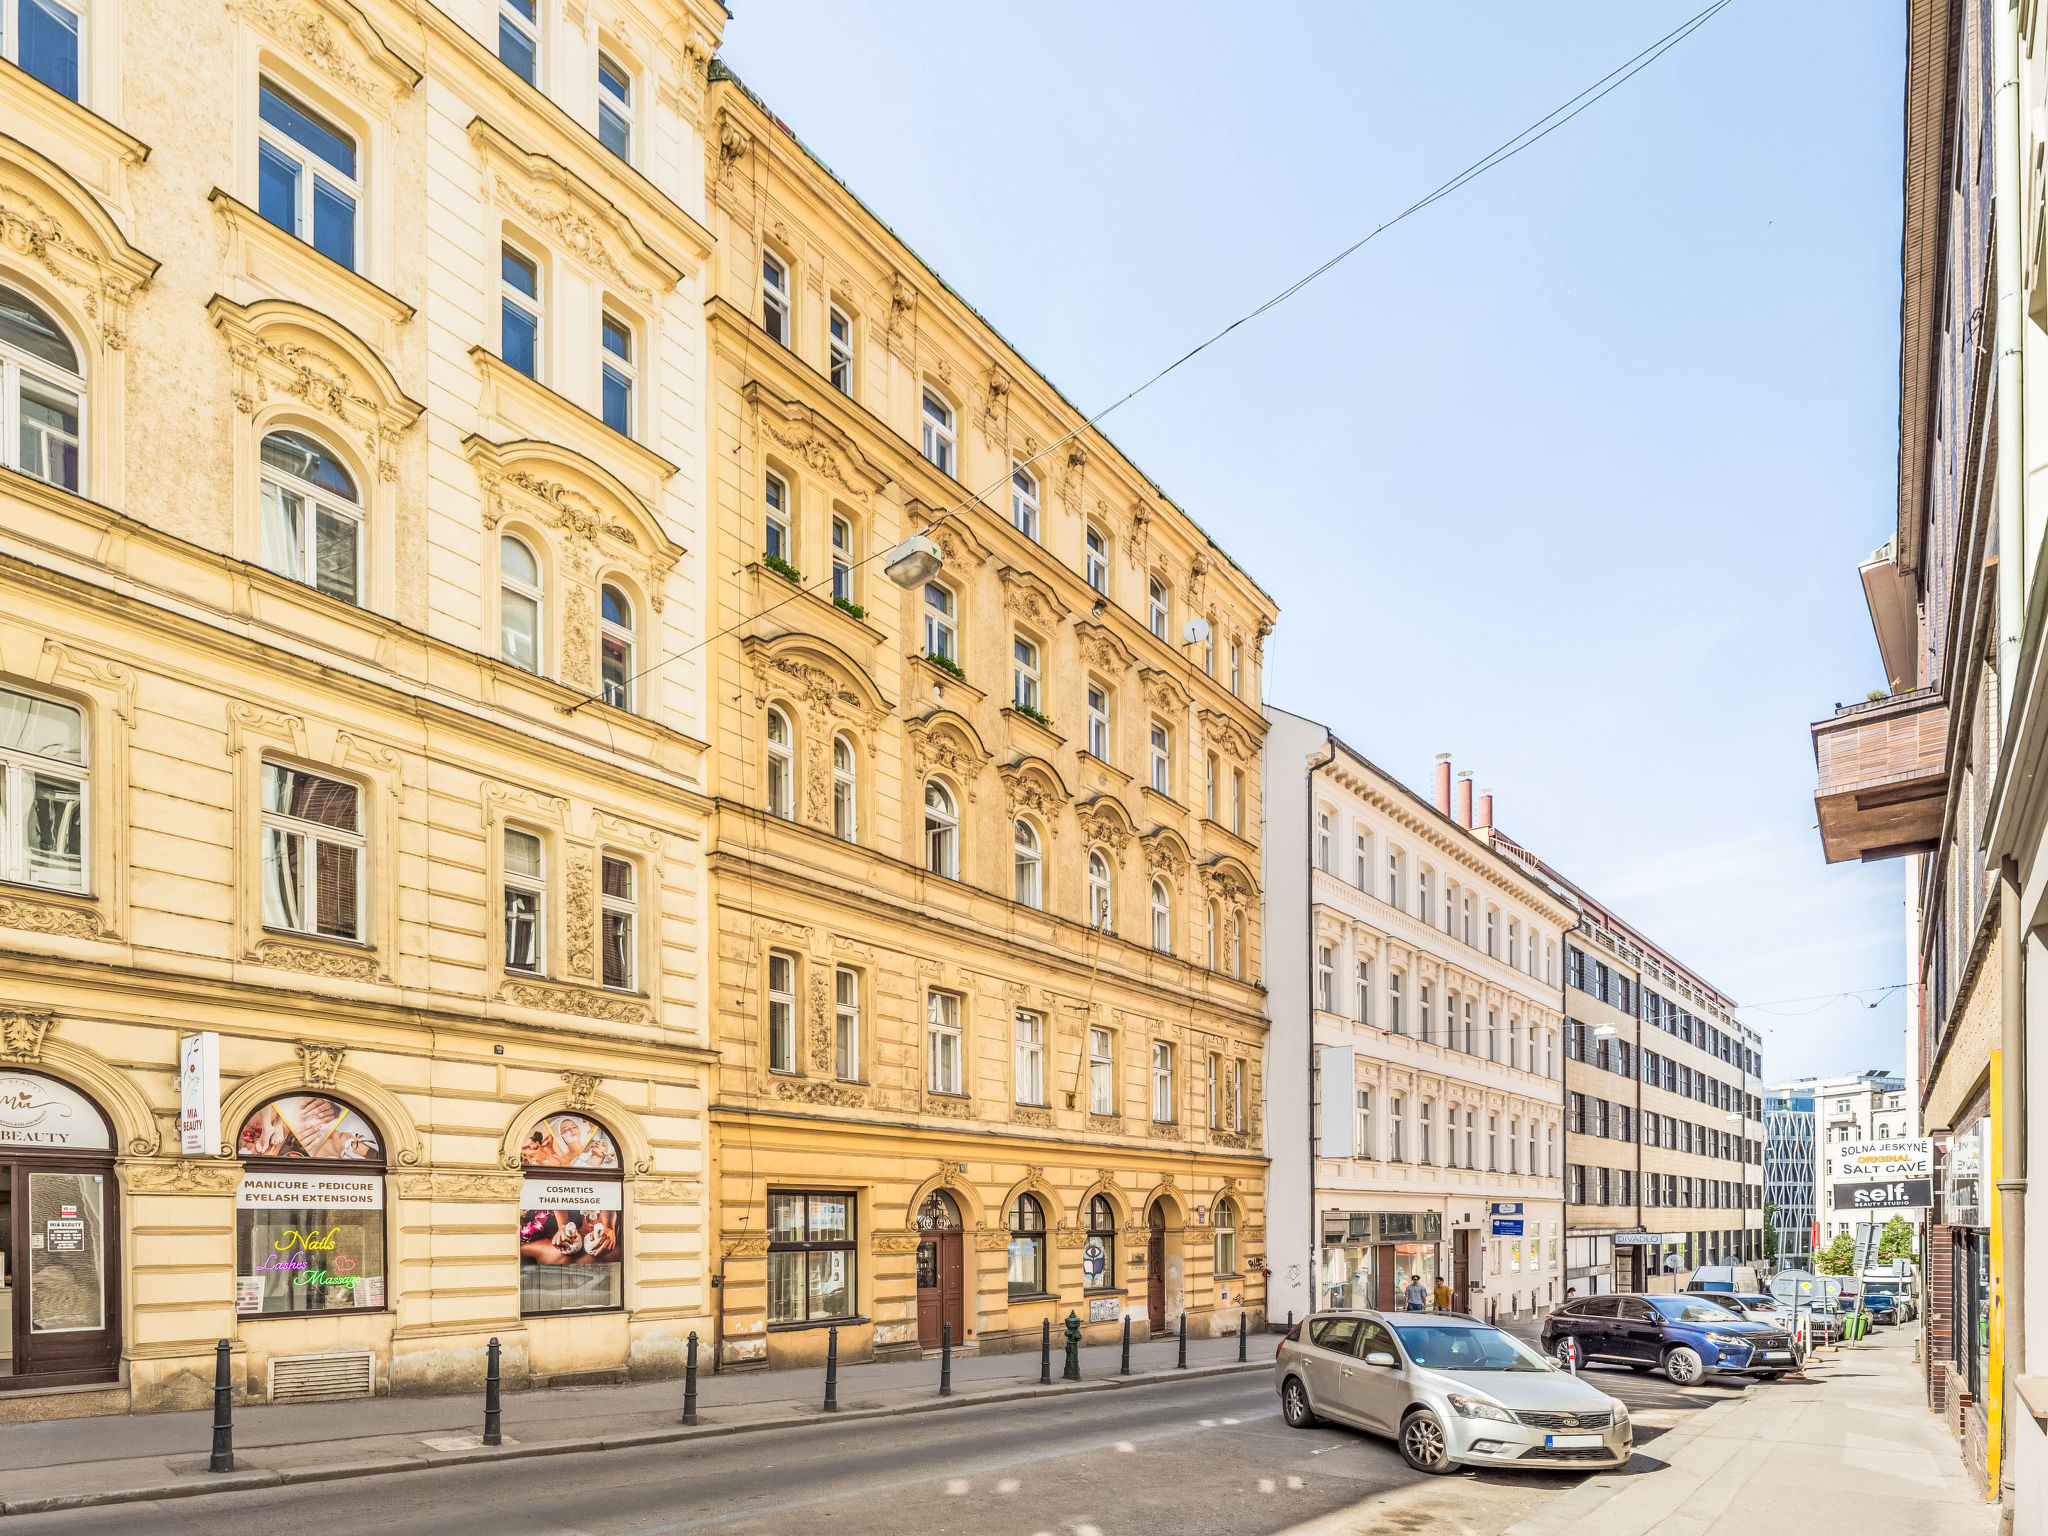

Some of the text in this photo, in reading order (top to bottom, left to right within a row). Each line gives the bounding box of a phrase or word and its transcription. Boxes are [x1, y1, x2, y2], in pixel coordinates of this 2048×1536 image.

[187, 1108, 198, 1119] MIA
[183, 1120, 203, 1132] BEAUTY
[1, 1131, 70, 1143] BEAUTY
[1841, 1141, 1928, 1157] SOLNÁ JESKYNĚ
[1857, 1154, 1912, 1164] ORIGINAL
[1843, 1160, 1927, 1175] SALT CAVE
[244, 1180, 309, 1190] MANICURE
[318, 1182, 374, 1191] PEDICURE
[546, 1186, 594, 1194] COSMETICS
[245, 1193, 374, 1203] EYELASH EXTENSIONS
[539, 1196, 559, 1204] THAI
[274, 1227, 341, 1251] Nails
[1617, 1235, 1659, 1243] DIVADLO
[255, 1250, 308, 1271] Lashes
[293, 1269, 361, 1290] Massage
